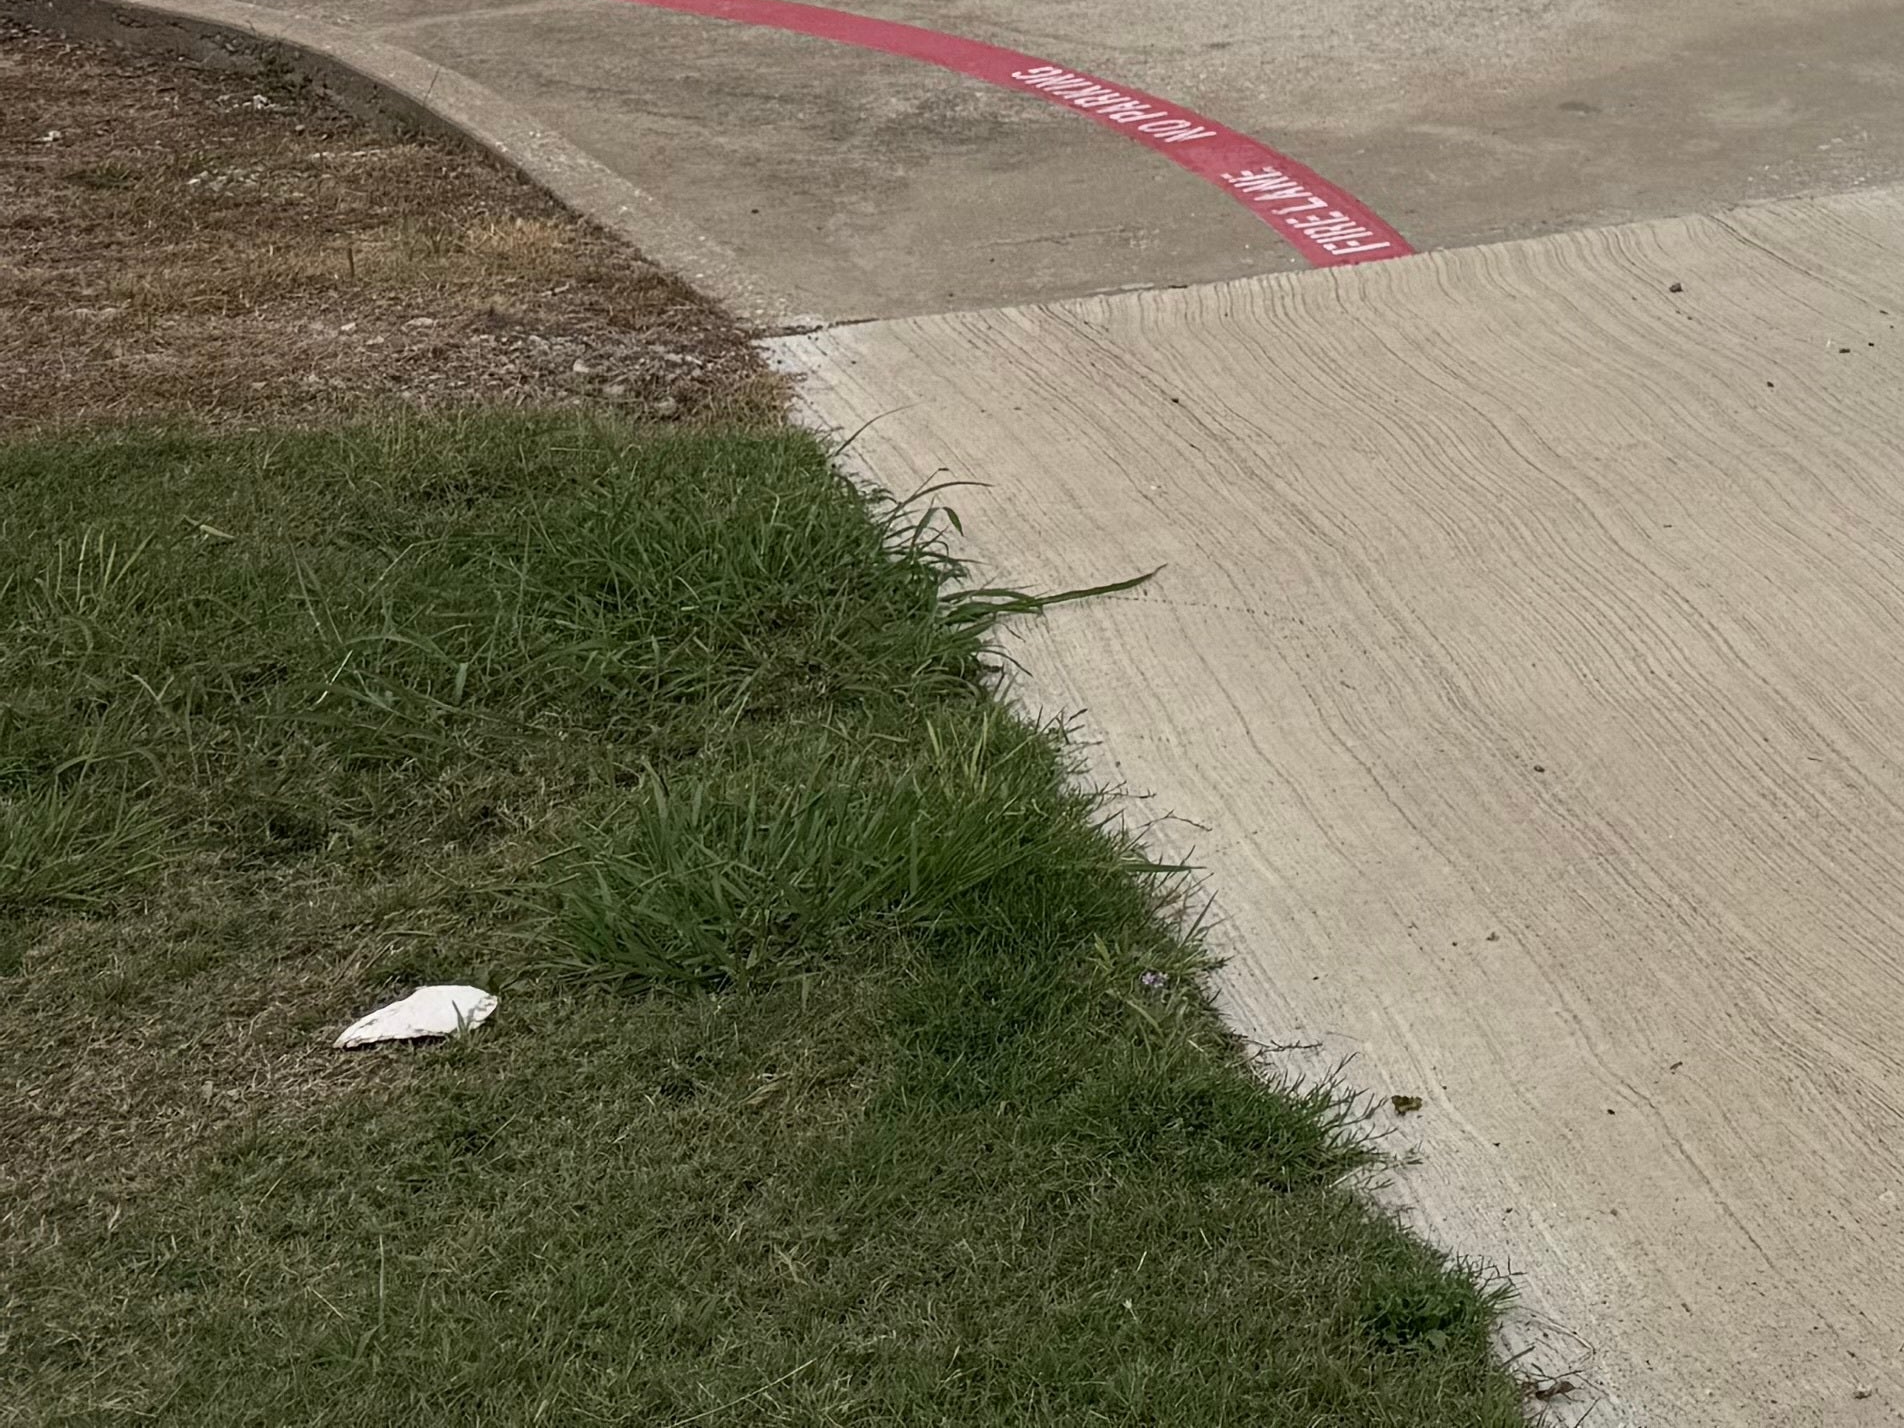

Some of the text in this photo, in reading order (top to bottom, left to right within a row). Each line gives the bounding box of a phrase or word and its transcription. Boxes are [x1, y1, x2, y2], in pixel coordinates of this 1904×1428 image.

[1011, 66, 1217, 142] NO PARKING
[1220, 165, 1391, 256] FIRE LANE
